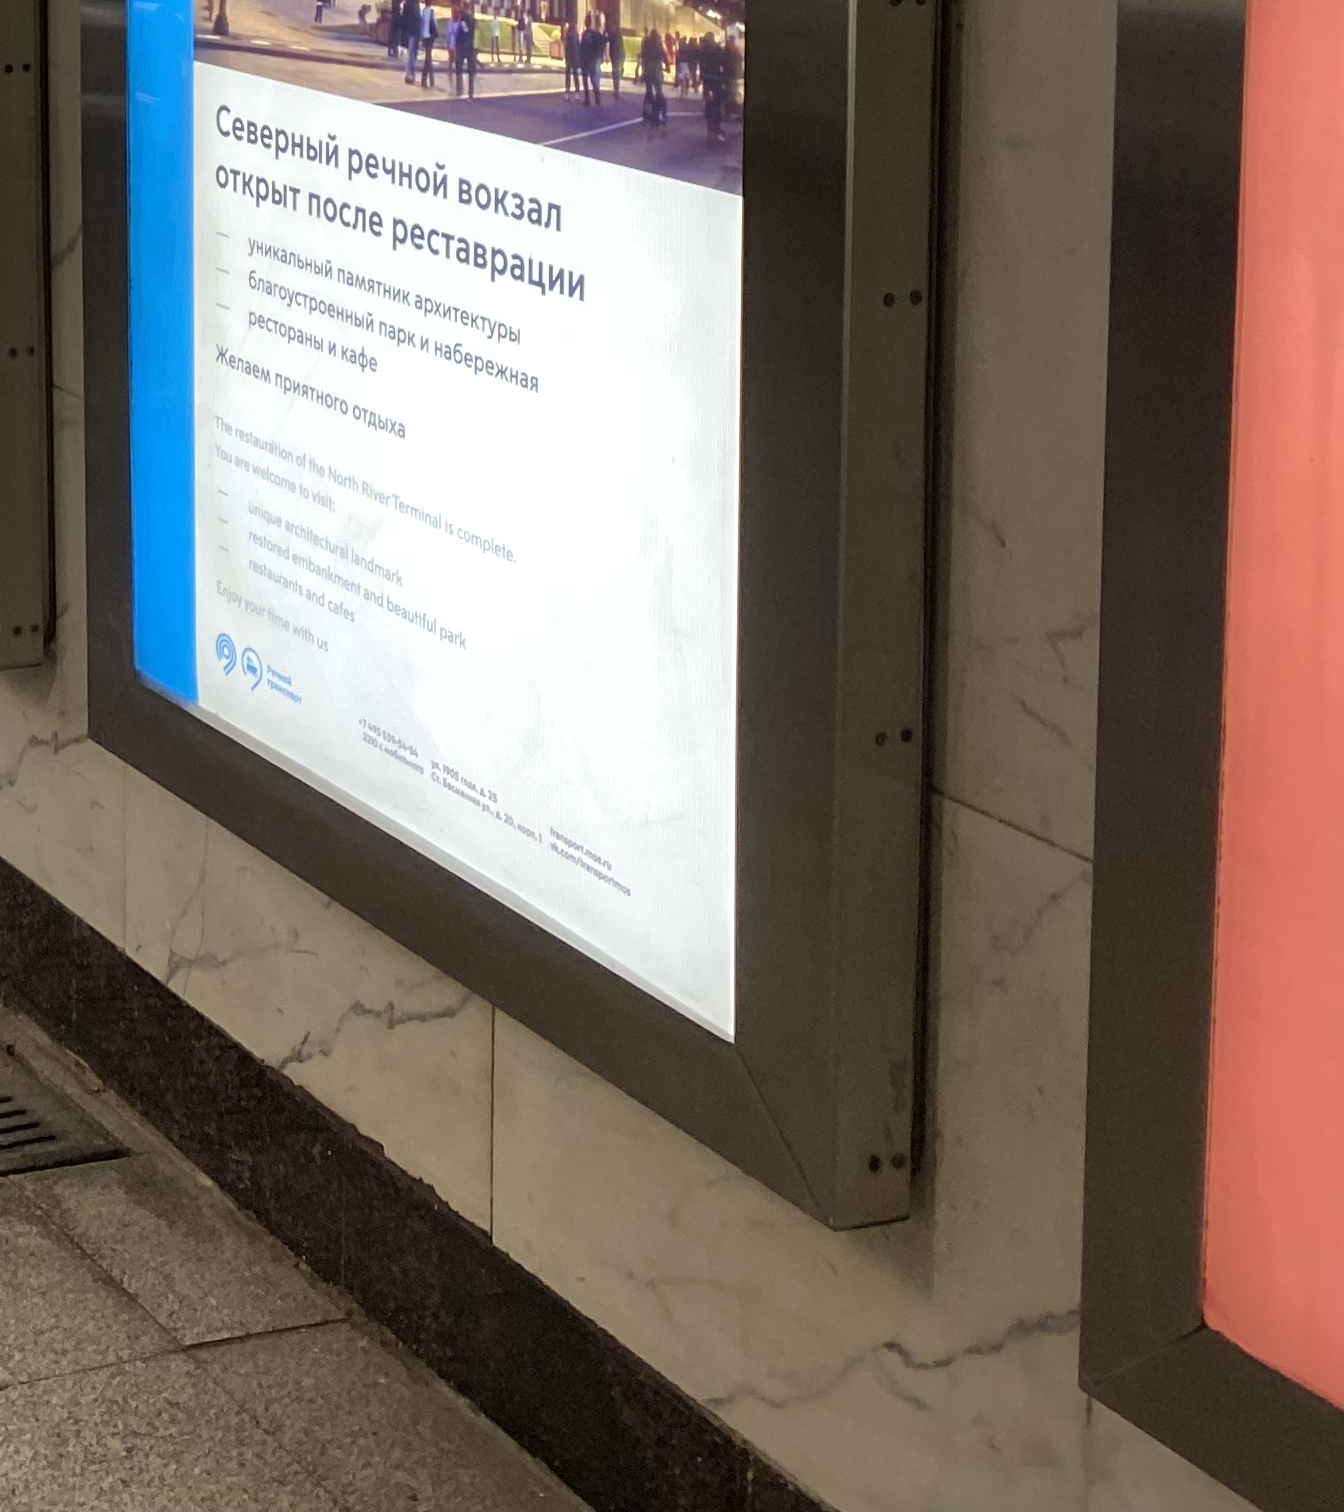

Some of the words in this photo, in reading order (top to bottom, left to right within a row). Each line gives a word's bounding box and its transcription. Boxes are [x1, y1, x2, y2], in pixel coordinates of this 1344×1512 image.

[216, 104, 339, 168] Северный
[347, 145, 448, 200] речной
[458, 179, 562, 231] вокзал
[216, 161, 301, 213] открыт
[309, 183, 383, 239] после
[392, 216, 585, 302] реставрации
[247, 236, 333, 281] уникальный
[337, 265, 411, 308] памятник
[415, 290, 521, 345] архитектуры
[249, 270, 374, 333] благоустроенный
[379, 316, 416, 351] парк
[421, 333, 429, 349] и
[435, 338, 539, 393] набережная
[216, 345, 271, 386] Желаем
[275, 368, 348, 417] приятного
[353, 401, 406, 439] отдыха
[249, 310, 323, 356] рестораны
[328, 338, 337, 353] и
[341, 340, 378, 374] кафе
[214, 445, 232, 464] You
[234, 457, 250, 472] are
[252, 464, 296, 493] welcome
[299, 485, 309, 499] to
[214, 416, 232, 435] The
[296, 452, 308, 469] of
[309, 458, 325, 478] the
[328, 467, 358, 493] North
[362, 481, 390, 505] River
[393, 490, 441, 529] Terminal
[445, 517, 454, 534] is
[457, 528, 517, 563] complete.
[249, 503, 282, 529] unique
[284, 519, 349, 559] architectural
[351, 549, 403, 586] landmark
[249, 531, 290, 560] restored
[292, 546, 361, 598] embankment
[363, 587, 384, 607] and
[387, 596, 437, 634] beautiful
[440, 623, 467, 649] park
[249, 559, 303, 597] restaurants
[306, 584, 324, 606] and
[328, 598, 355, 622] cafes
[216, 580, 242, 608] Enjoy
[244, 598, 266, 616] your
[268, 607, 290, 632] time
[292, 618, 314, 643] with
[317, 635, 328, 652] us
